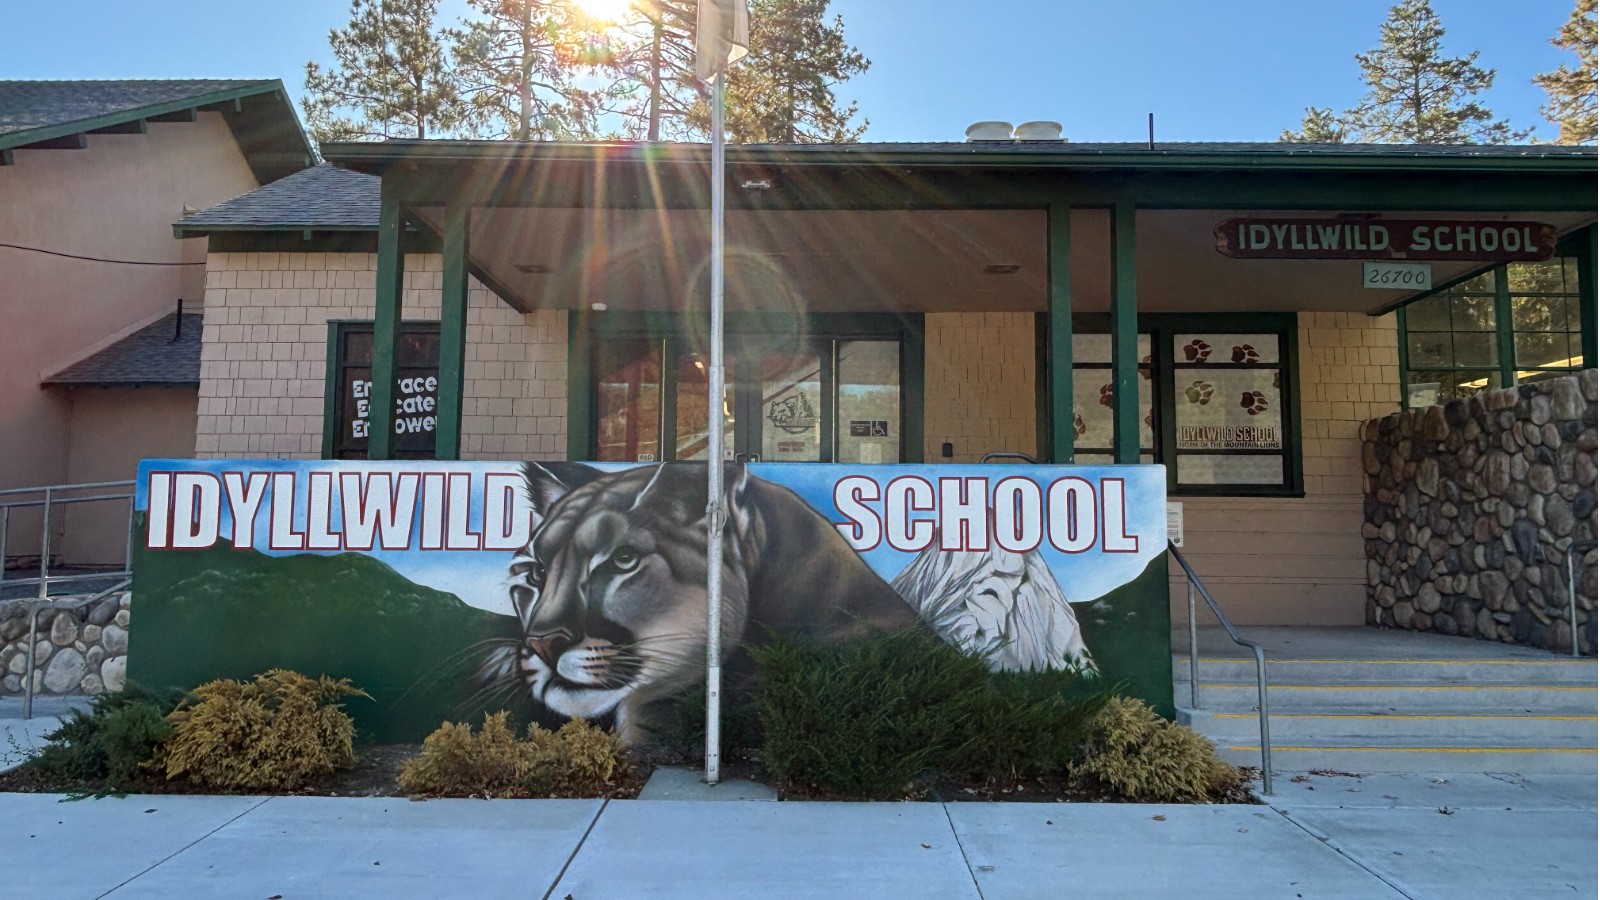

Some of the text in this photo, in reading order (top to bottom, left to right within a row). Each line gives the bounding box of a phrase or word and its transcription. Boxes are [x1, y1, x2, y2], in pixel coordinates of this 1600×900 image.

[1238, 224, 1538, 253] IDYLLWILD SCHOOL
[1369, 269, 1426, 285] 26700
[352, 376, 438, 398] Eace
[357, 395, 436, 418] Eate
[352, 416, 438, 438] Eowe
[1179, 426, 1280, 441] IDYLLWILD SCHOOL
[146, 471, 1140, 554] IDYLLWILD SCHOOL
